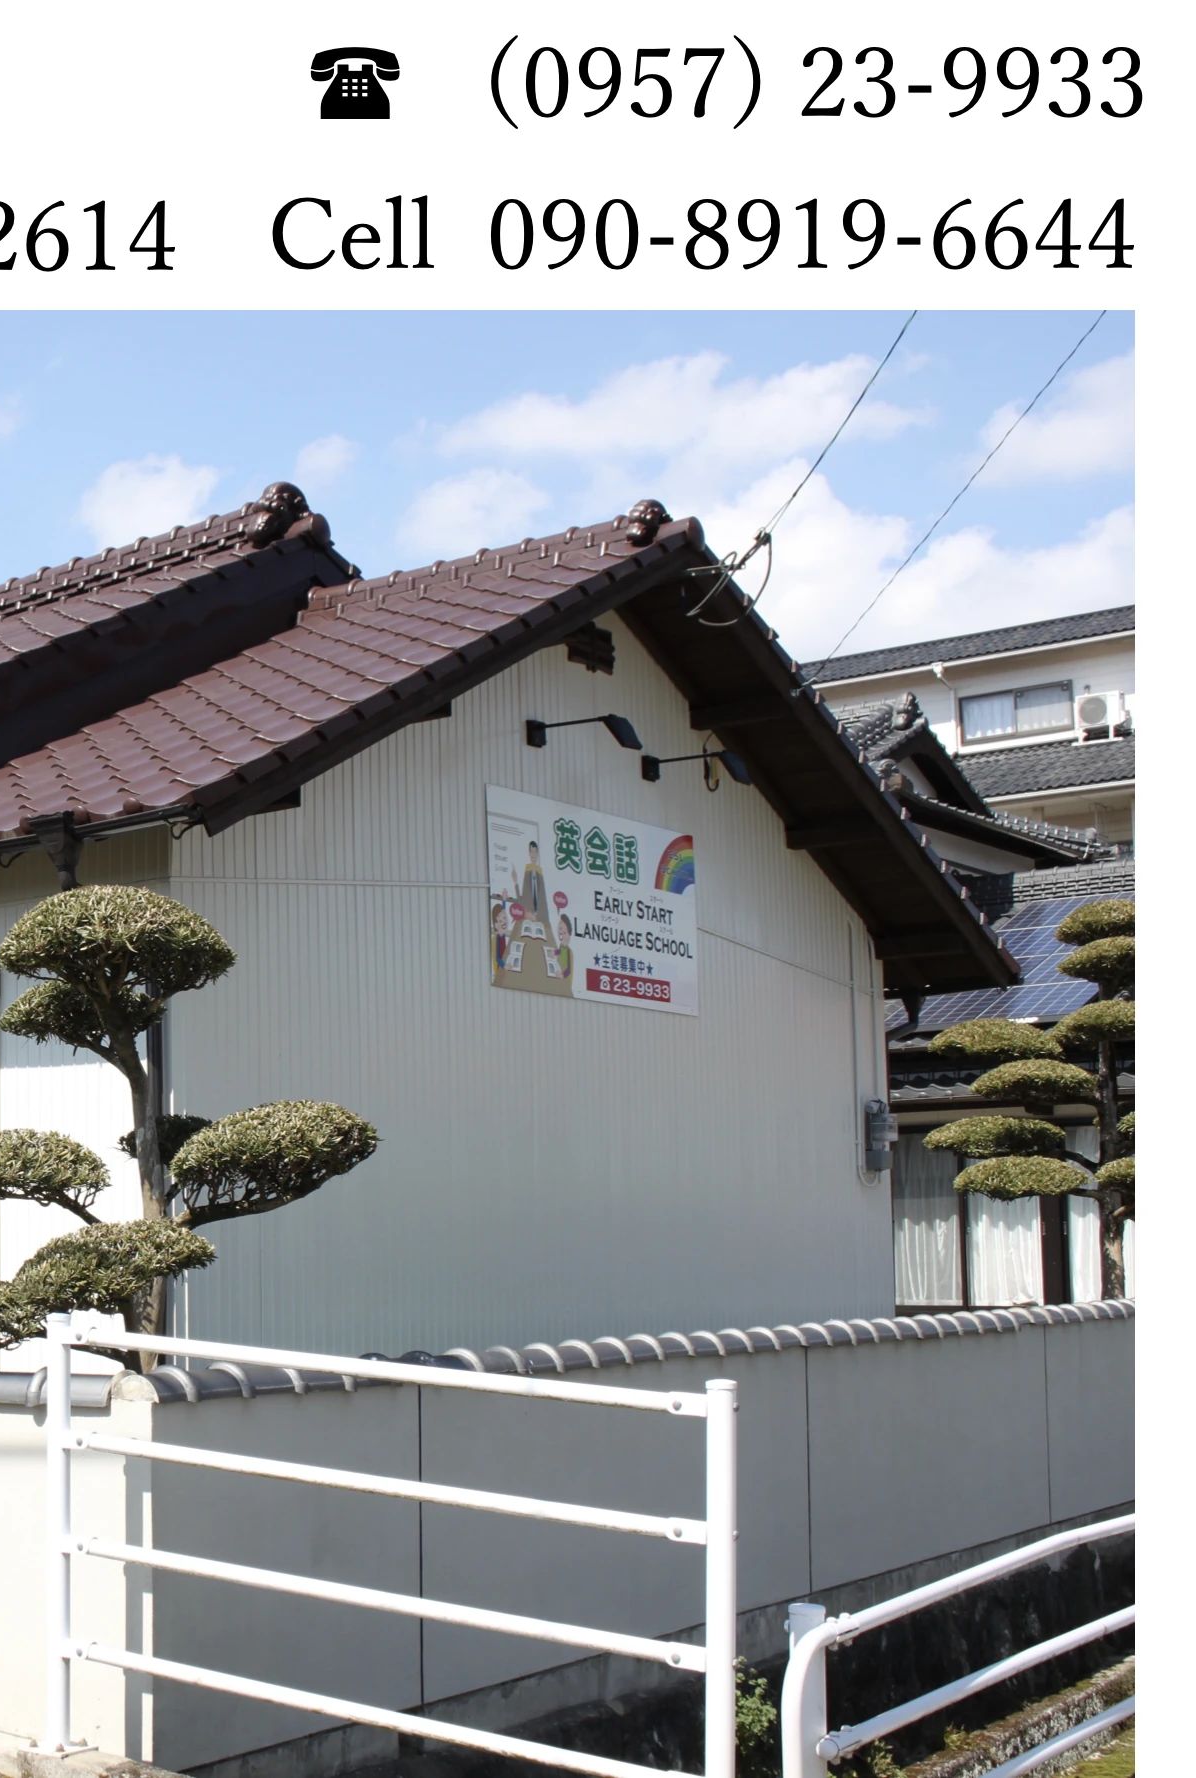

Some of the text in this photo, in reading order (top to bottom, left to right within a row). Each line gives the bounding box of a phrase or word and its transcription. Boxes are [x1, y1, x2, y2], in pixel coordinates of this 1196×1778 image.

[553, 818, 639, 885] 英会話
[594, 890, 633, 917] EARLY
[636, 900, 674, 926] START
[574, 917, 643, 949] LANGUAGE
[645, 932, 693, 959] SCHOOL
[612, 977, 670, 999] 23-9933
